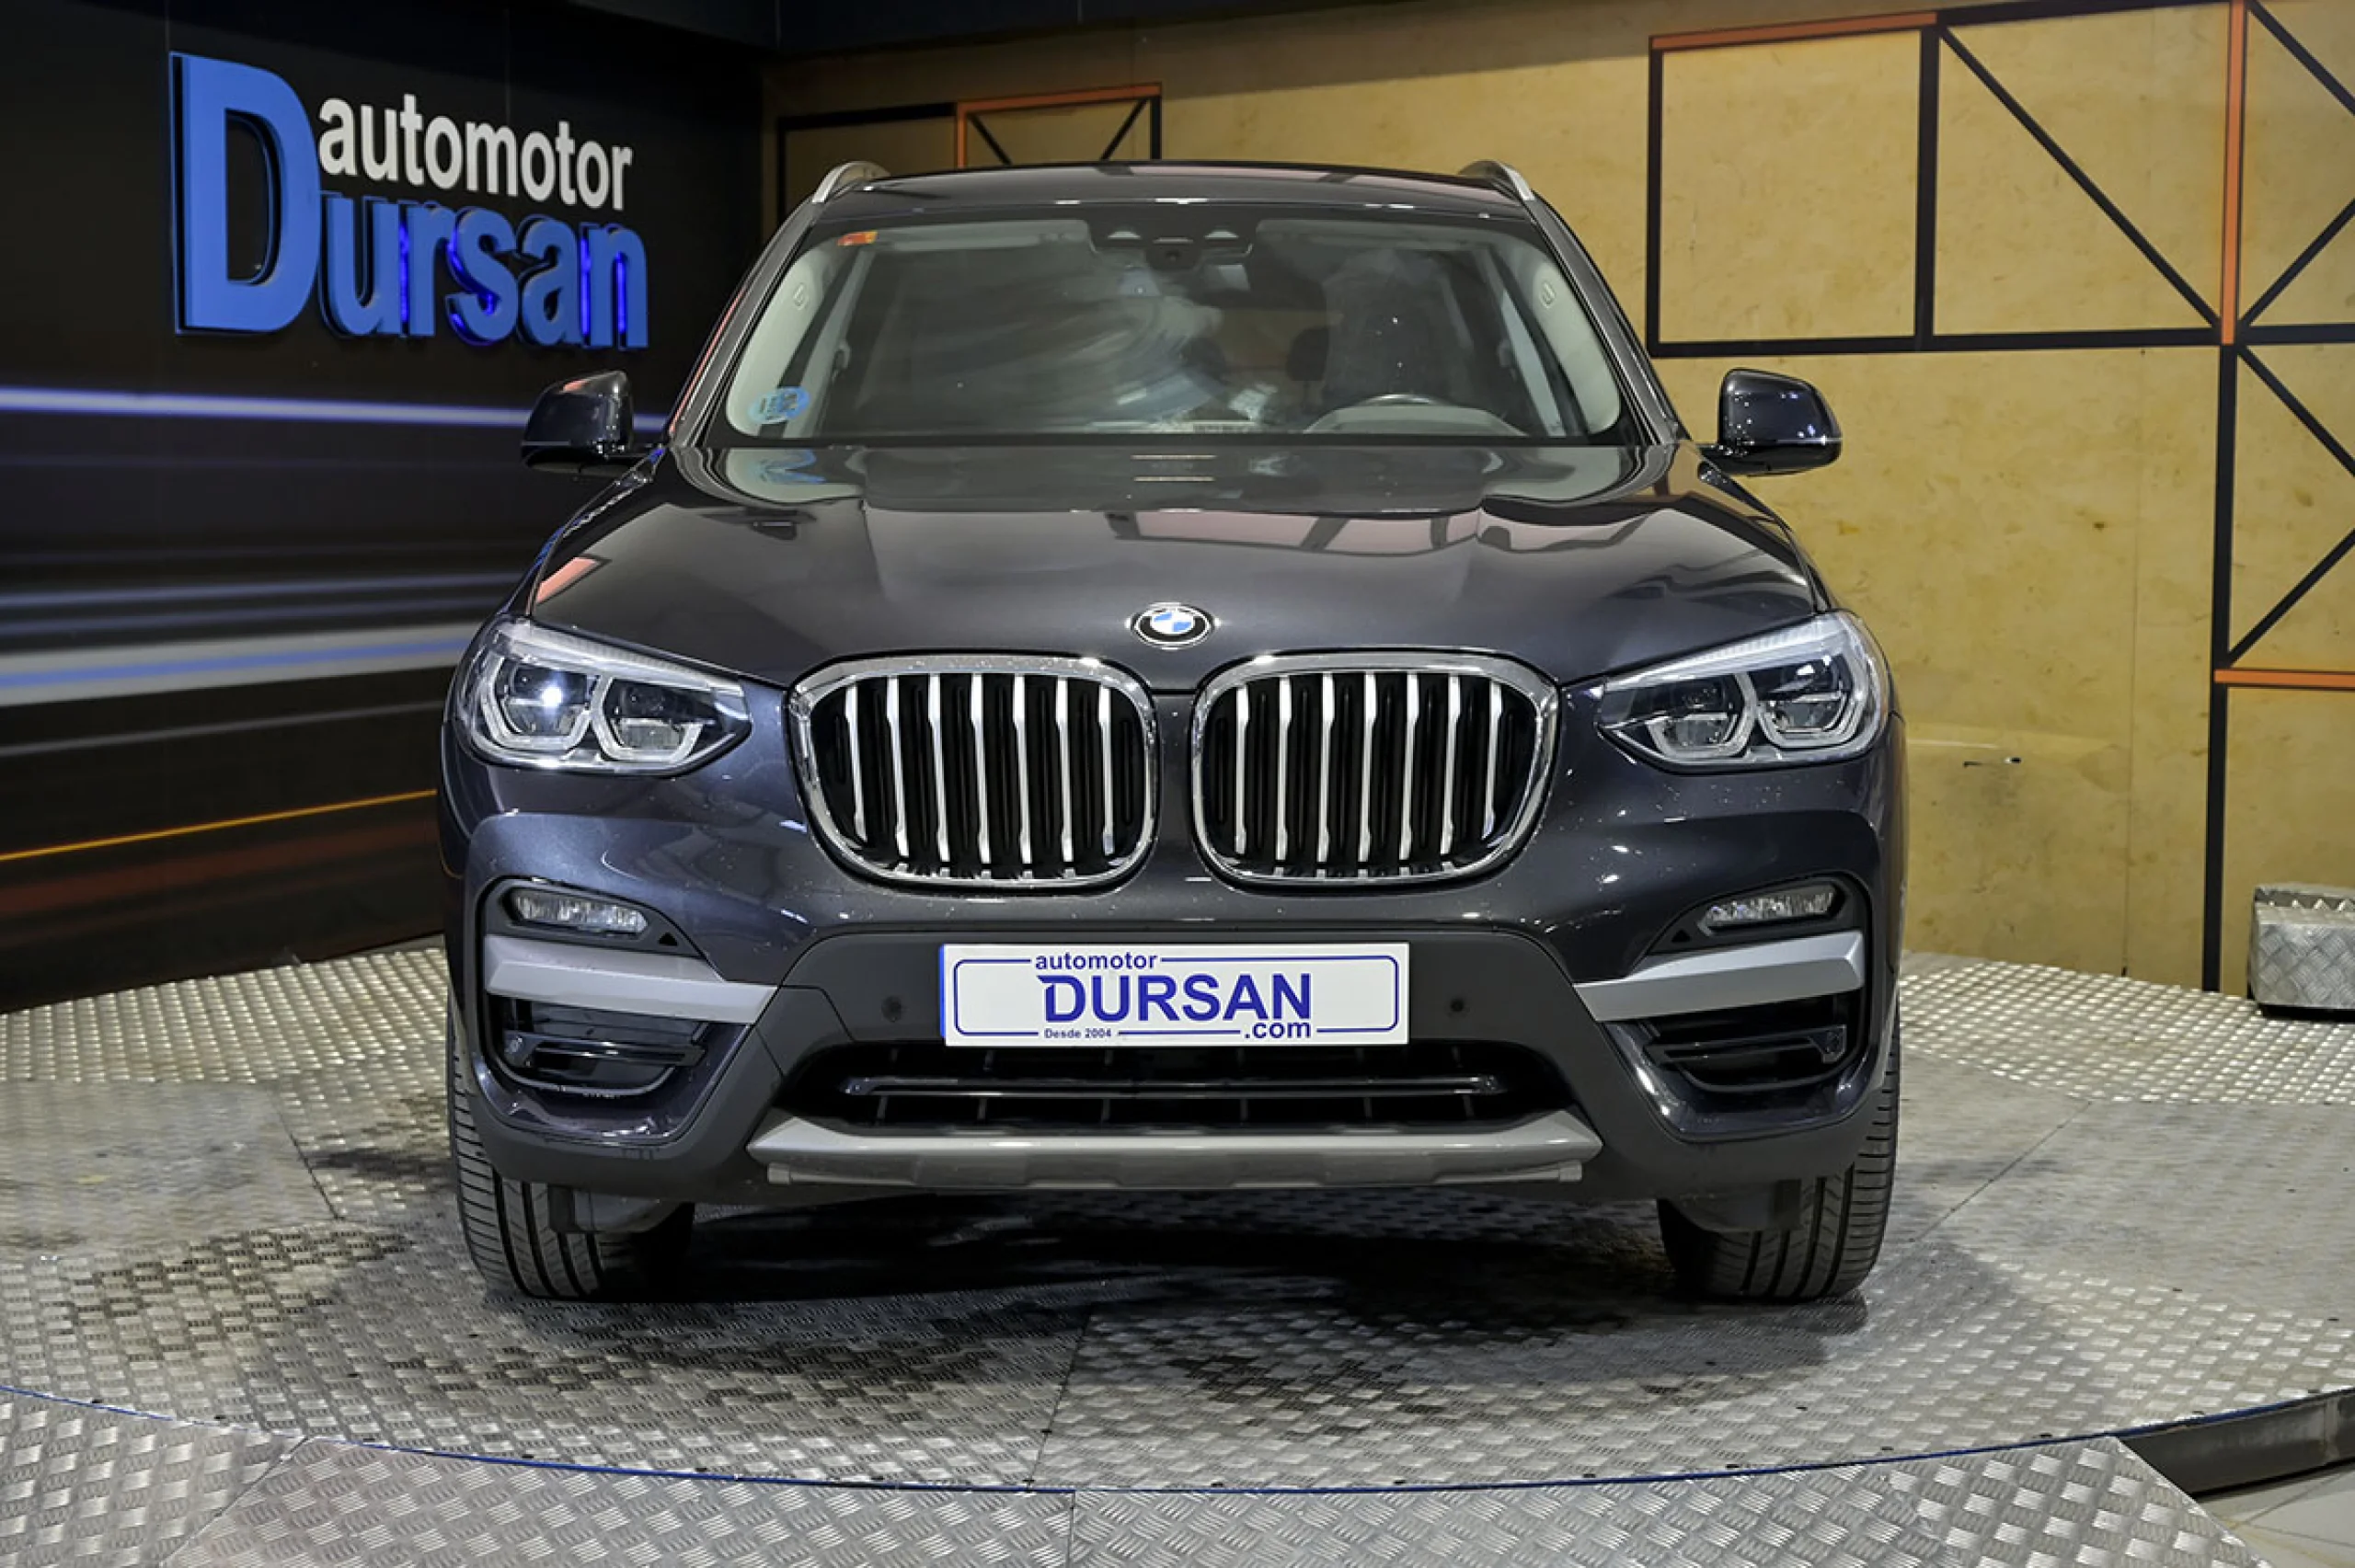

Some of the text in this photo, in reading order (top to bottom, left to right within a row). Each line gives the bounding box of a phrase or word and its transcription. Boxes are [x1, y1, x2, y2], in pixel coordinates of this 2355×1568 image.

[318, 94, 633, 211] automotor
[169, 51, 649, 350] Dursan
[1035, 951, 1158, 970] automotor
[1036, 973, 1311, 1023] DURSAN
[1044, 1028, 1112, 1039] Desde 2004
[1244, 1022, 1312, 1039] .com
